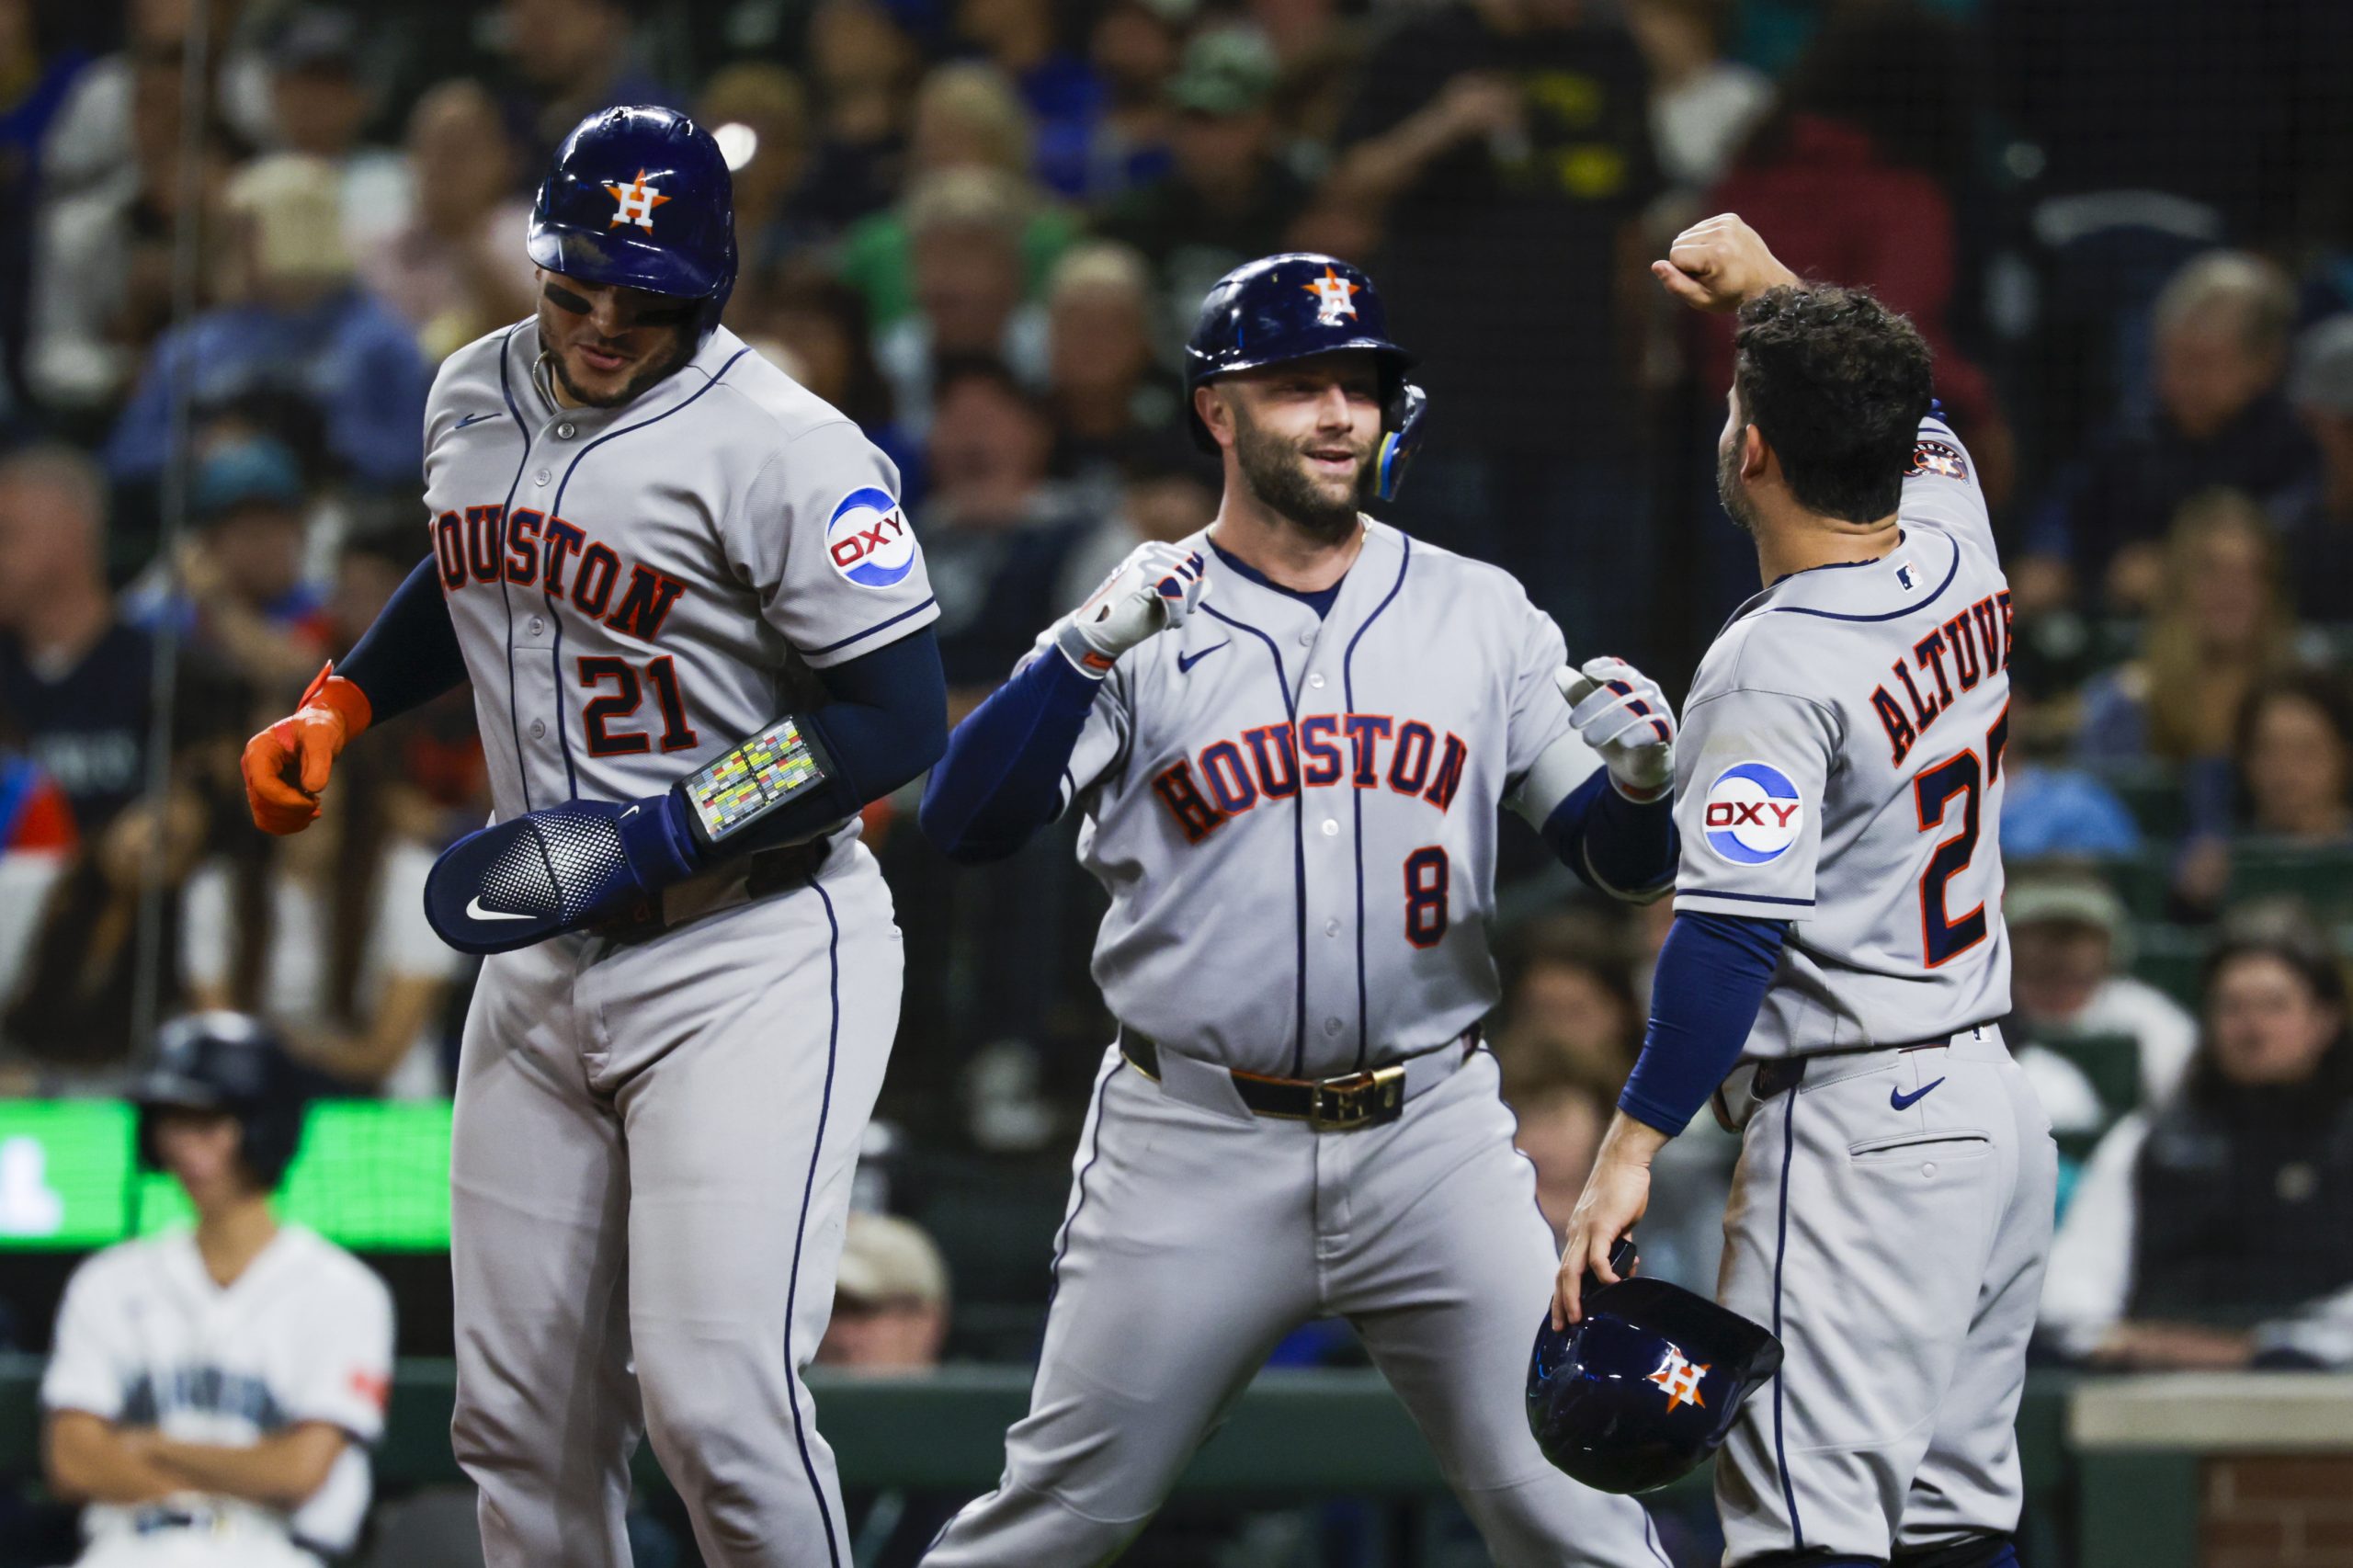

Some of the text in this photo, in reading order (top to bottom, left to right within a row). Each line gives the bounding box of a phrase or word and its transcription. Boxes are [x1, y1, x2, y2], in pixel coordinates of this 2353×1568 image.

[612, 182, 660, 227] H
[1313, 278, 1357, 315] H
[831, 511, 904, 567] OXY
[429, 504, 687, 642] OUSTON
[577, 654, 698, 757] 21
[1152, 713, 1468, 845] HOUSTON
[1706, 802, 1799, 828] OXY
[1404, 845, 1449, 949] 8
[1657, 1354, 1707, 1406] H
